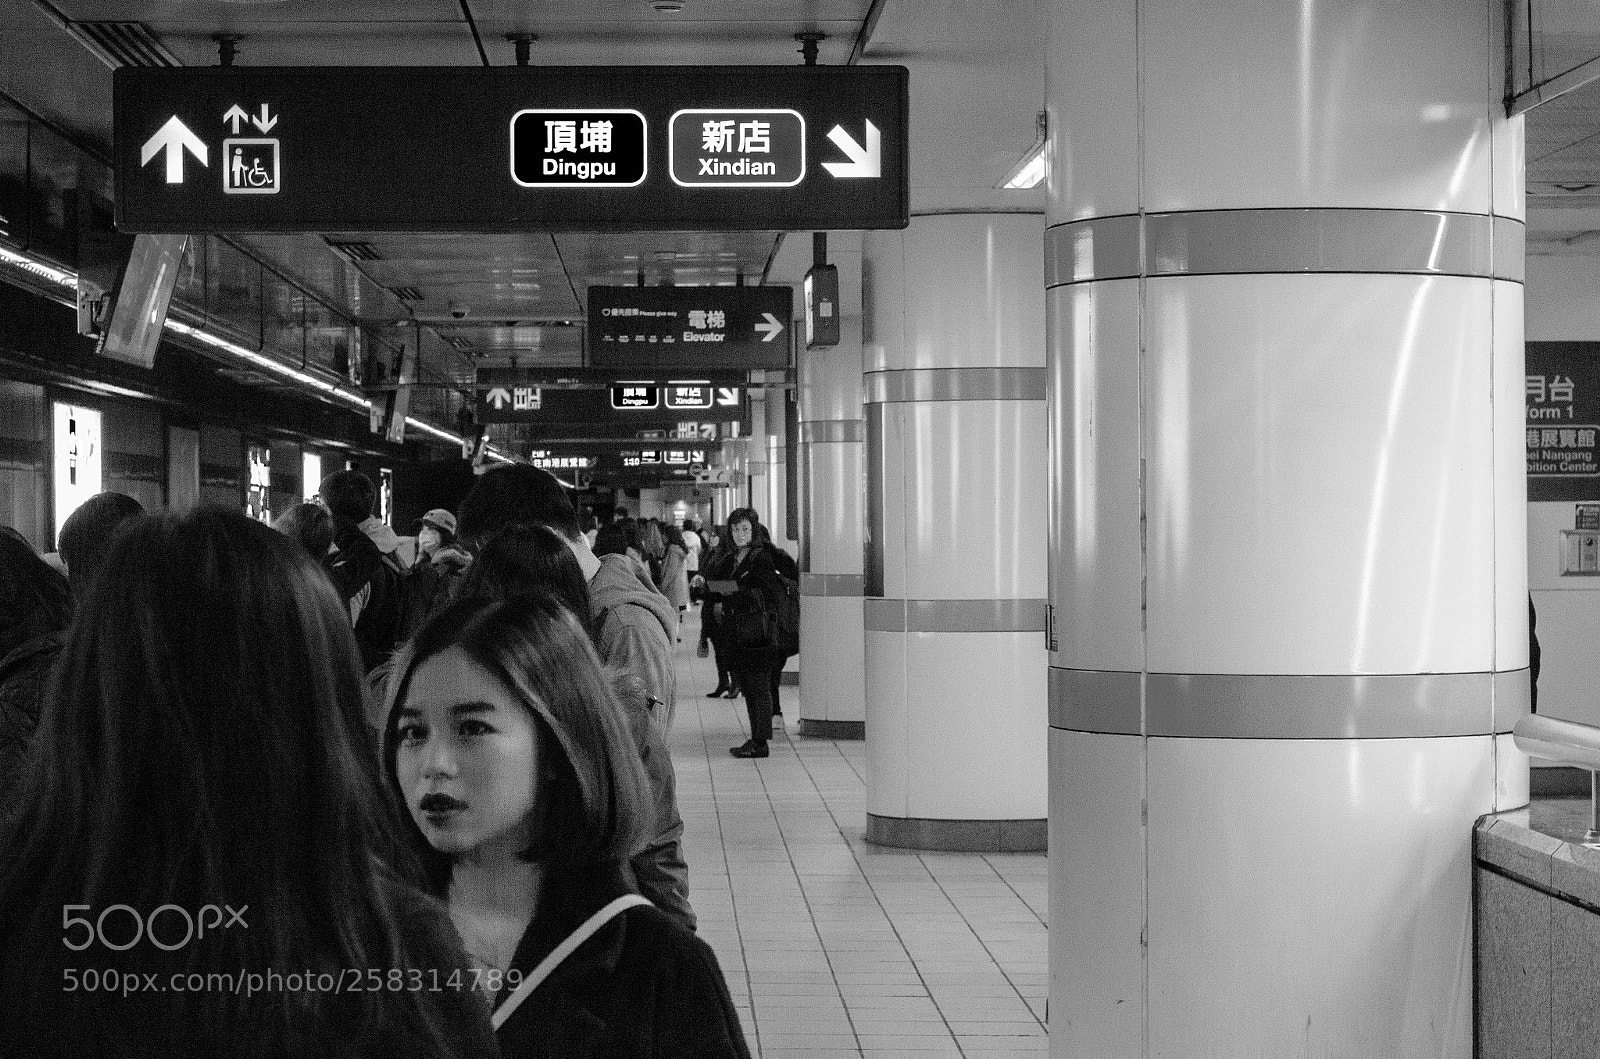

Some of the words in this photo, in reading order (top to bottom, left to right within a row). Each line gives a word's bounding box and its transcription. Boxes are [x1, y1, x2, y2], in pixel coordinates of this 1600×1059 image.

[544, 120, 614, 153] 頂埔
[702, 120, 771, 154] 新店
[542, 158, 617, 180] Dingpu
[698, 158, 776, 176] Xindian
[688, 310, 725, 329] 電梯
[683, 331, 726, 342] Elevator
[622, 398, 649, 406] Dingpu
[675, 397, 703, 405] Xindian
[1567, 405, 1573, 418] 1
[1542, 450, 1593, 462] Nangang
[1560, 461, 1598, 472] Center
